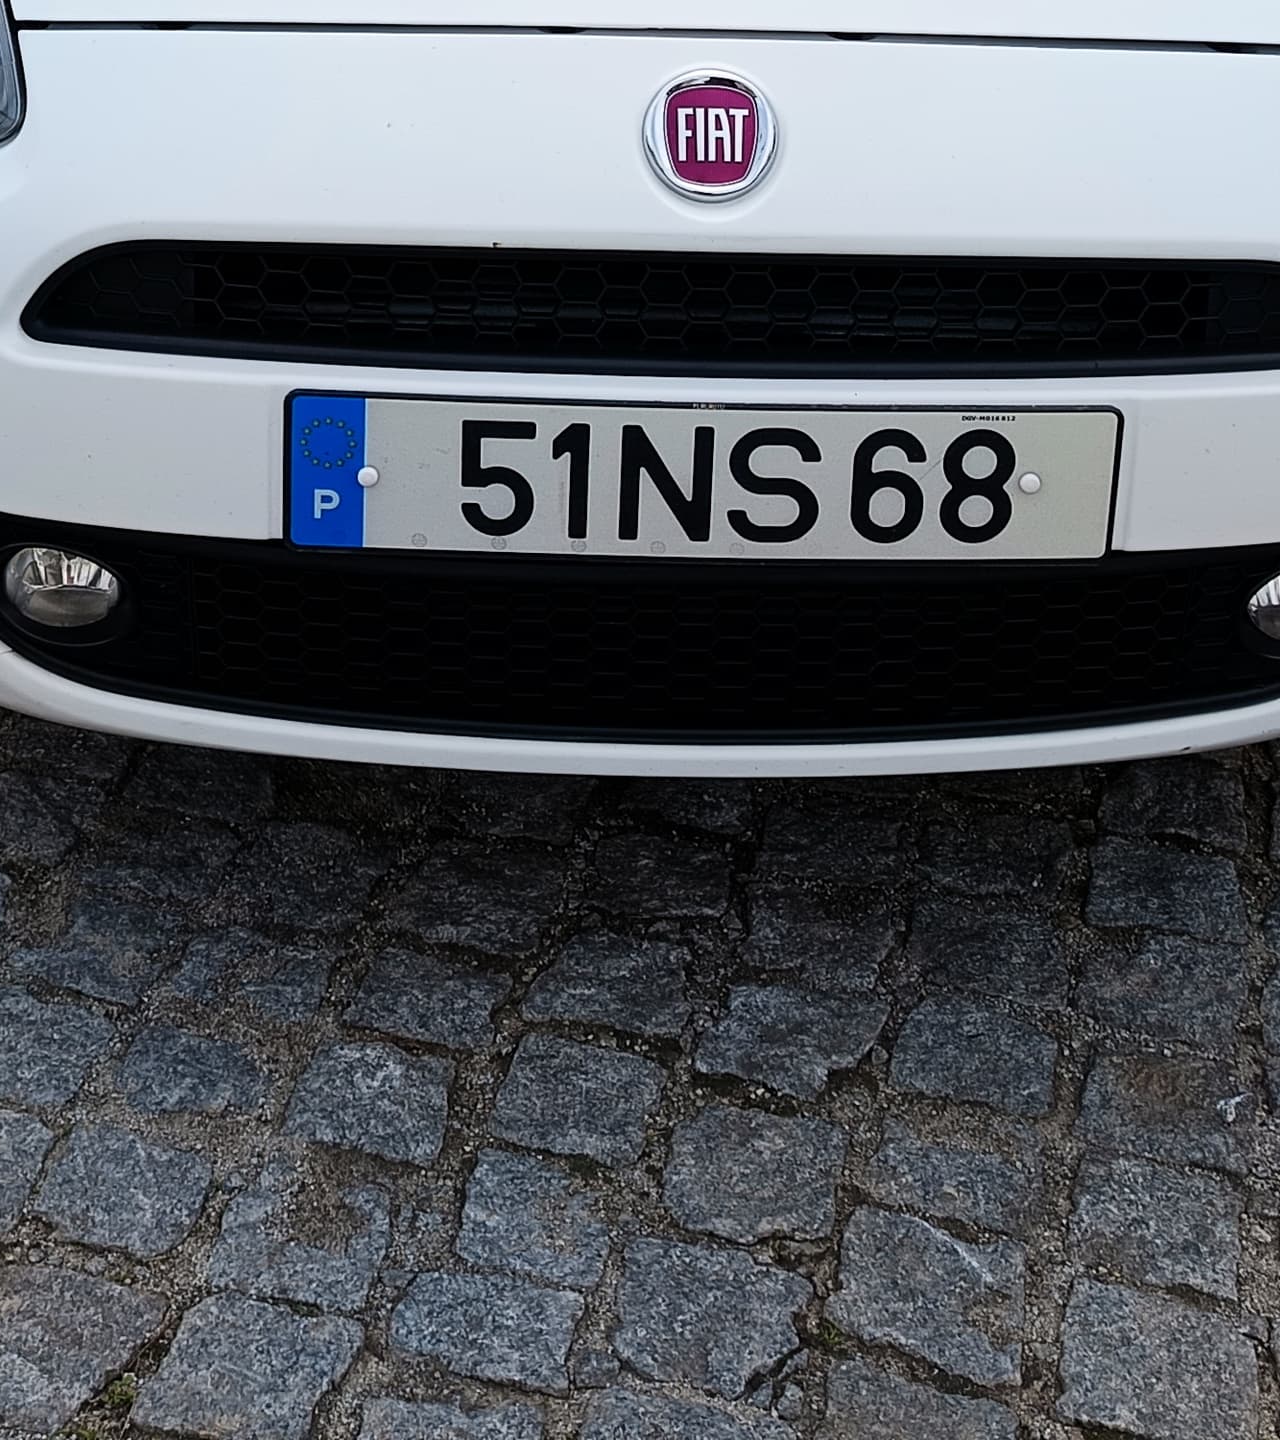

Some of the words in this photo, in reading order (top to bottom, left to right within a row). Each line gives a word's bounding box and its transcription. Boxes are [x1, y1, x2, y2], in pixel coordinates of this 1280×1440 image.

[677, 107, 750, 163] FIAT
[314, 489, 340, 519] P
[460, 419, 1016, 544] 51NS68
